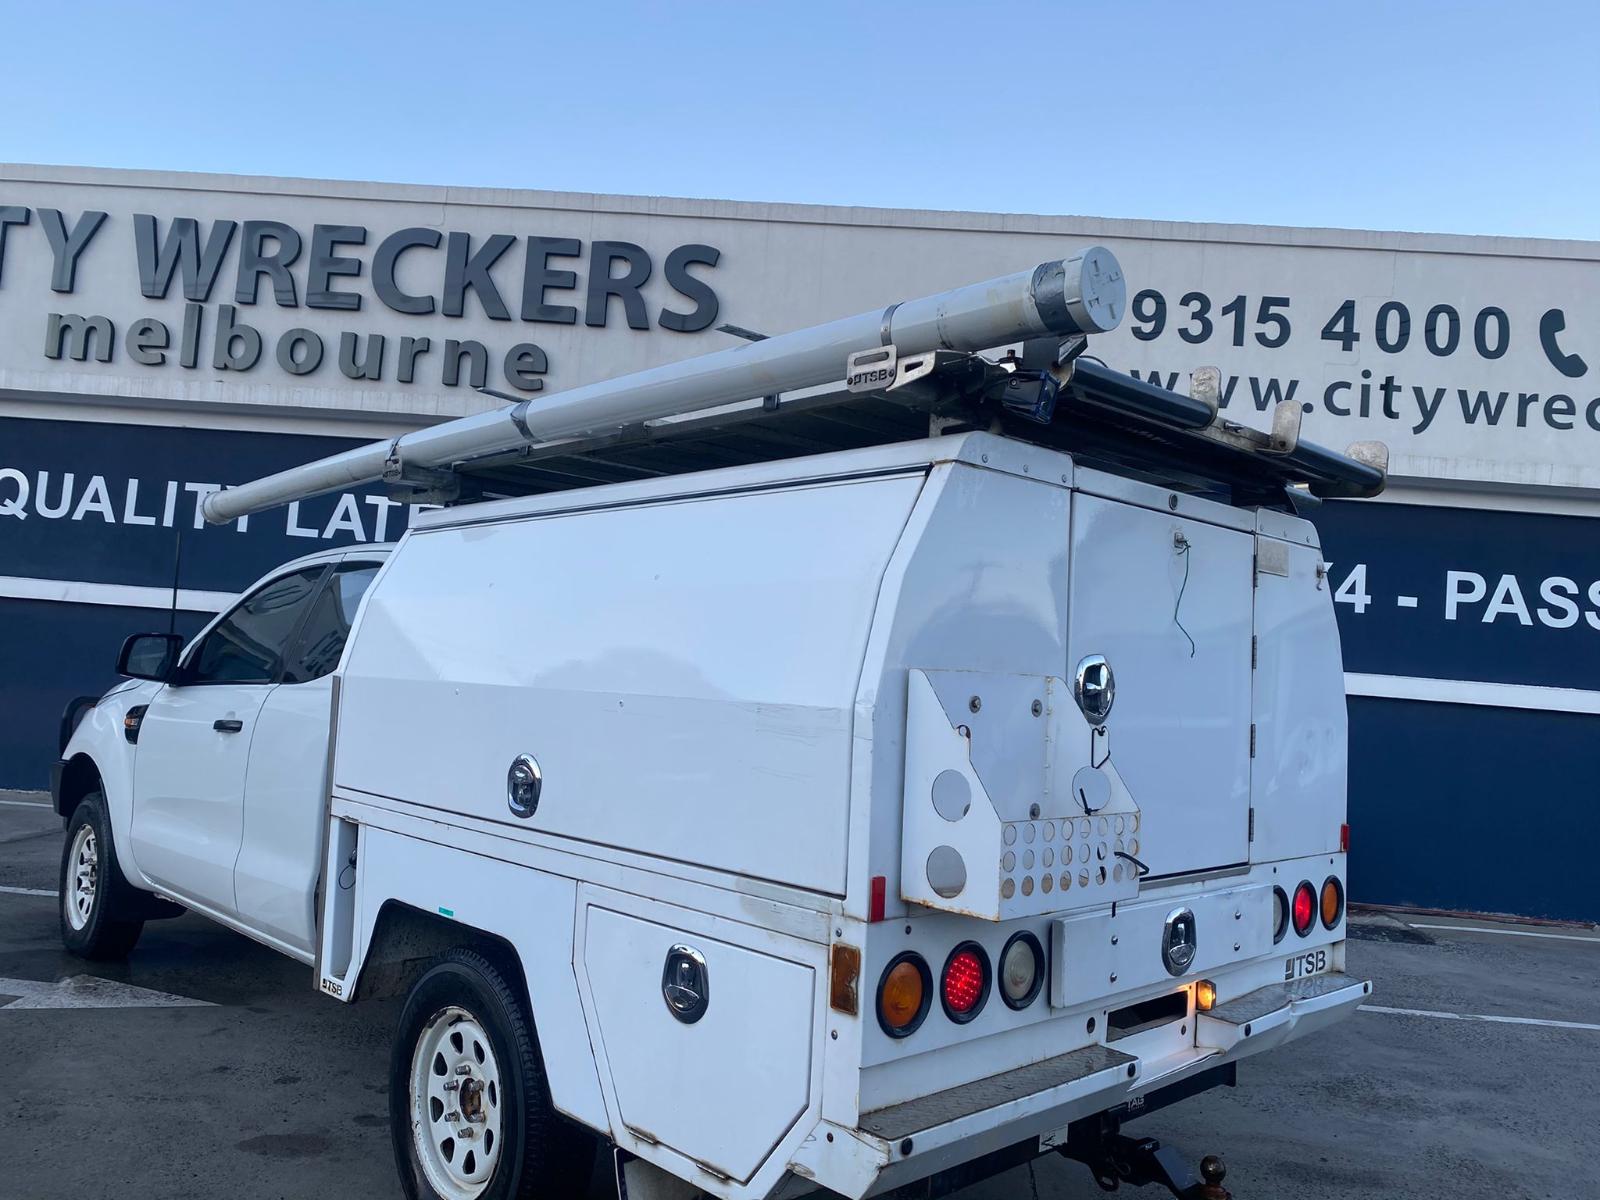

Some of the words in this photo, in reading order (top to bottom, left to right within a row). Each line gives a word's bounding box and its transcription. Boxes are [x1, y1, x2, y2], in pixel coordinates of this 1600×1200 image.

[133, 213, 721, 332] WRECKERS
[44, 303, 549, 391] melbourne
[1131, 289, 1292, 349] 9315
[1321, 300, 1510, 360] 4000
[286, 492, 445, 544] LAT
